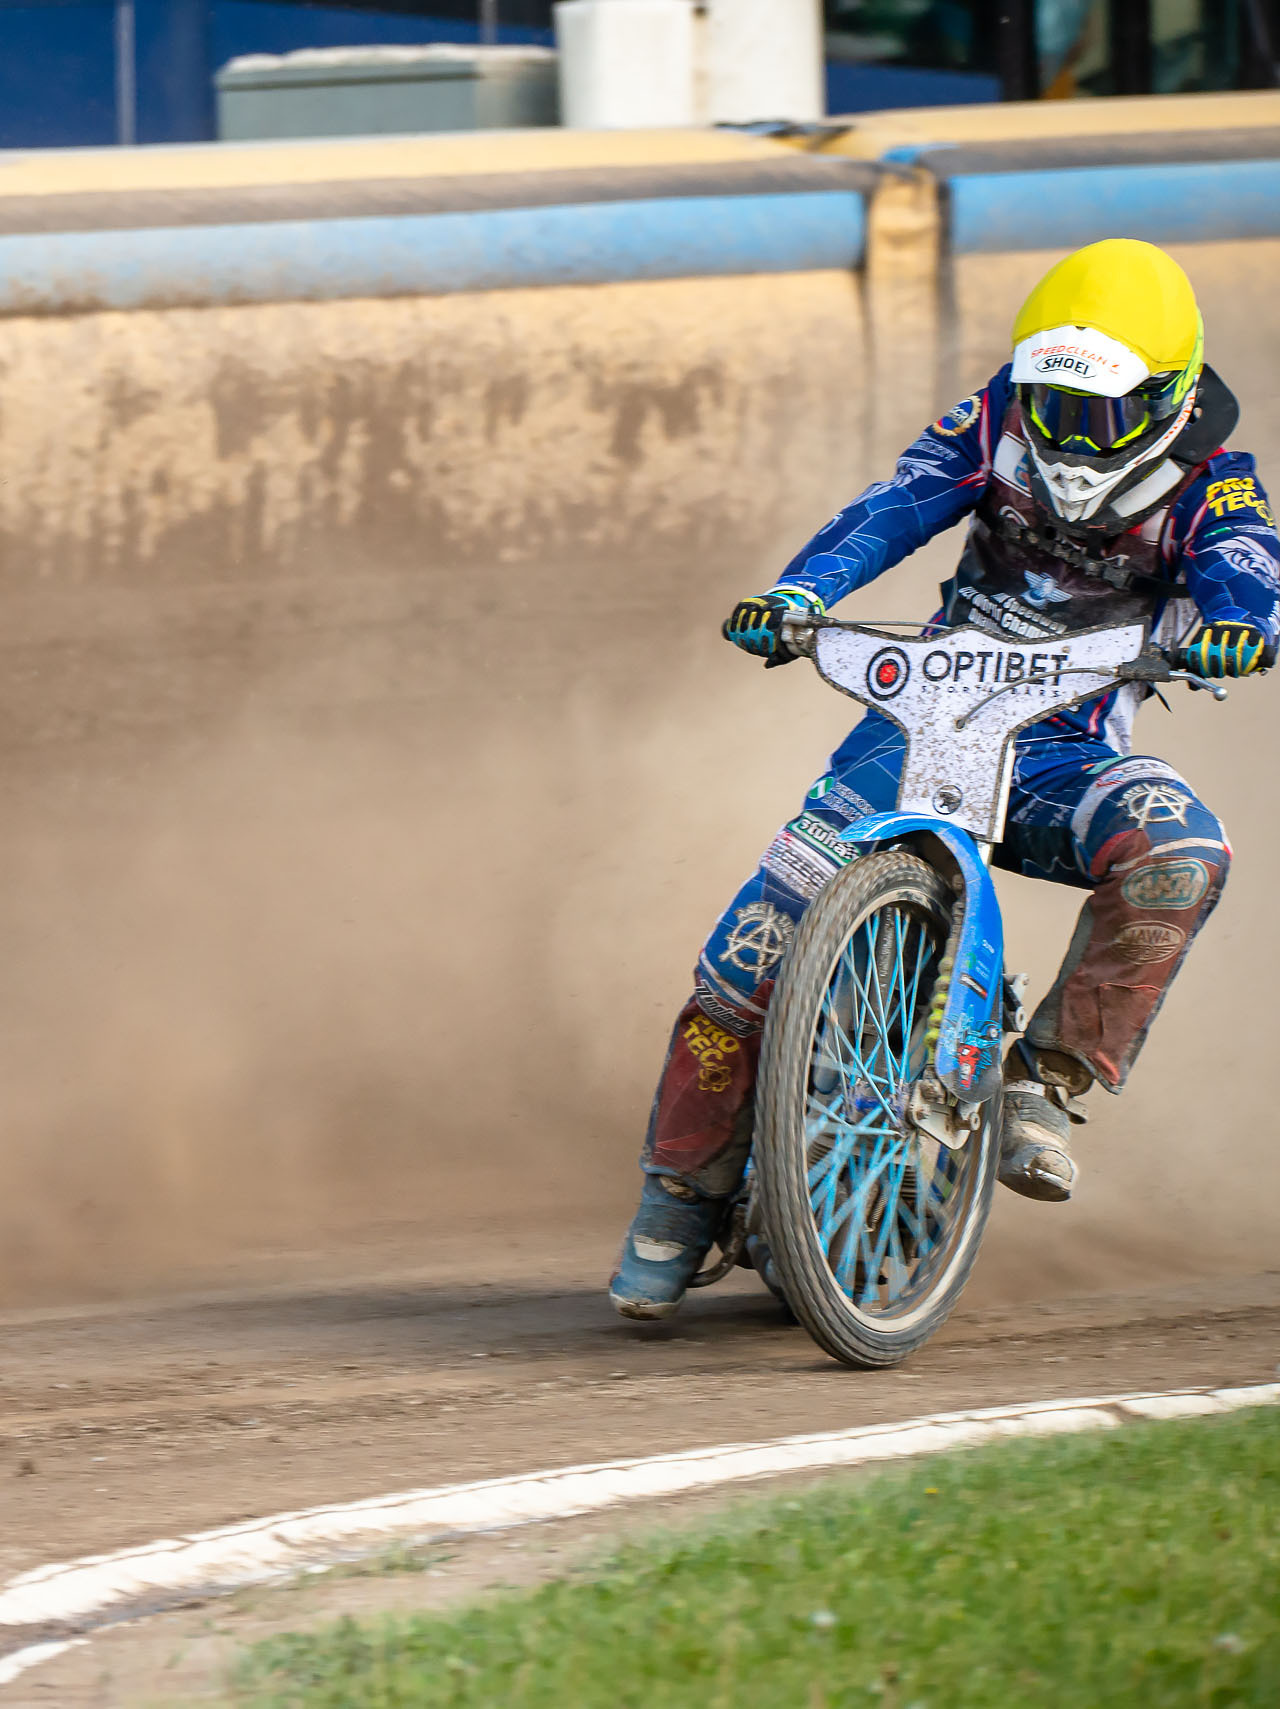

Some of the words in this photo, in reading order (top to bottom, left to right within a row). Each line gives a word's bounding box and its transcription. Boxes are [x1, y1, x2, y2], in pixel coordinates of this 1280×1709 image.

[1042, 357, 1089, 375] SHOEI
[1206, 477, 1256, 501] PRO
[1208, 491, 1265, 517] TEC
[922, 650, 1068, 686] OPTIBET
[683, 1021, 724, 1067] TEC
[694, 1014, 740, 1053] PRO
